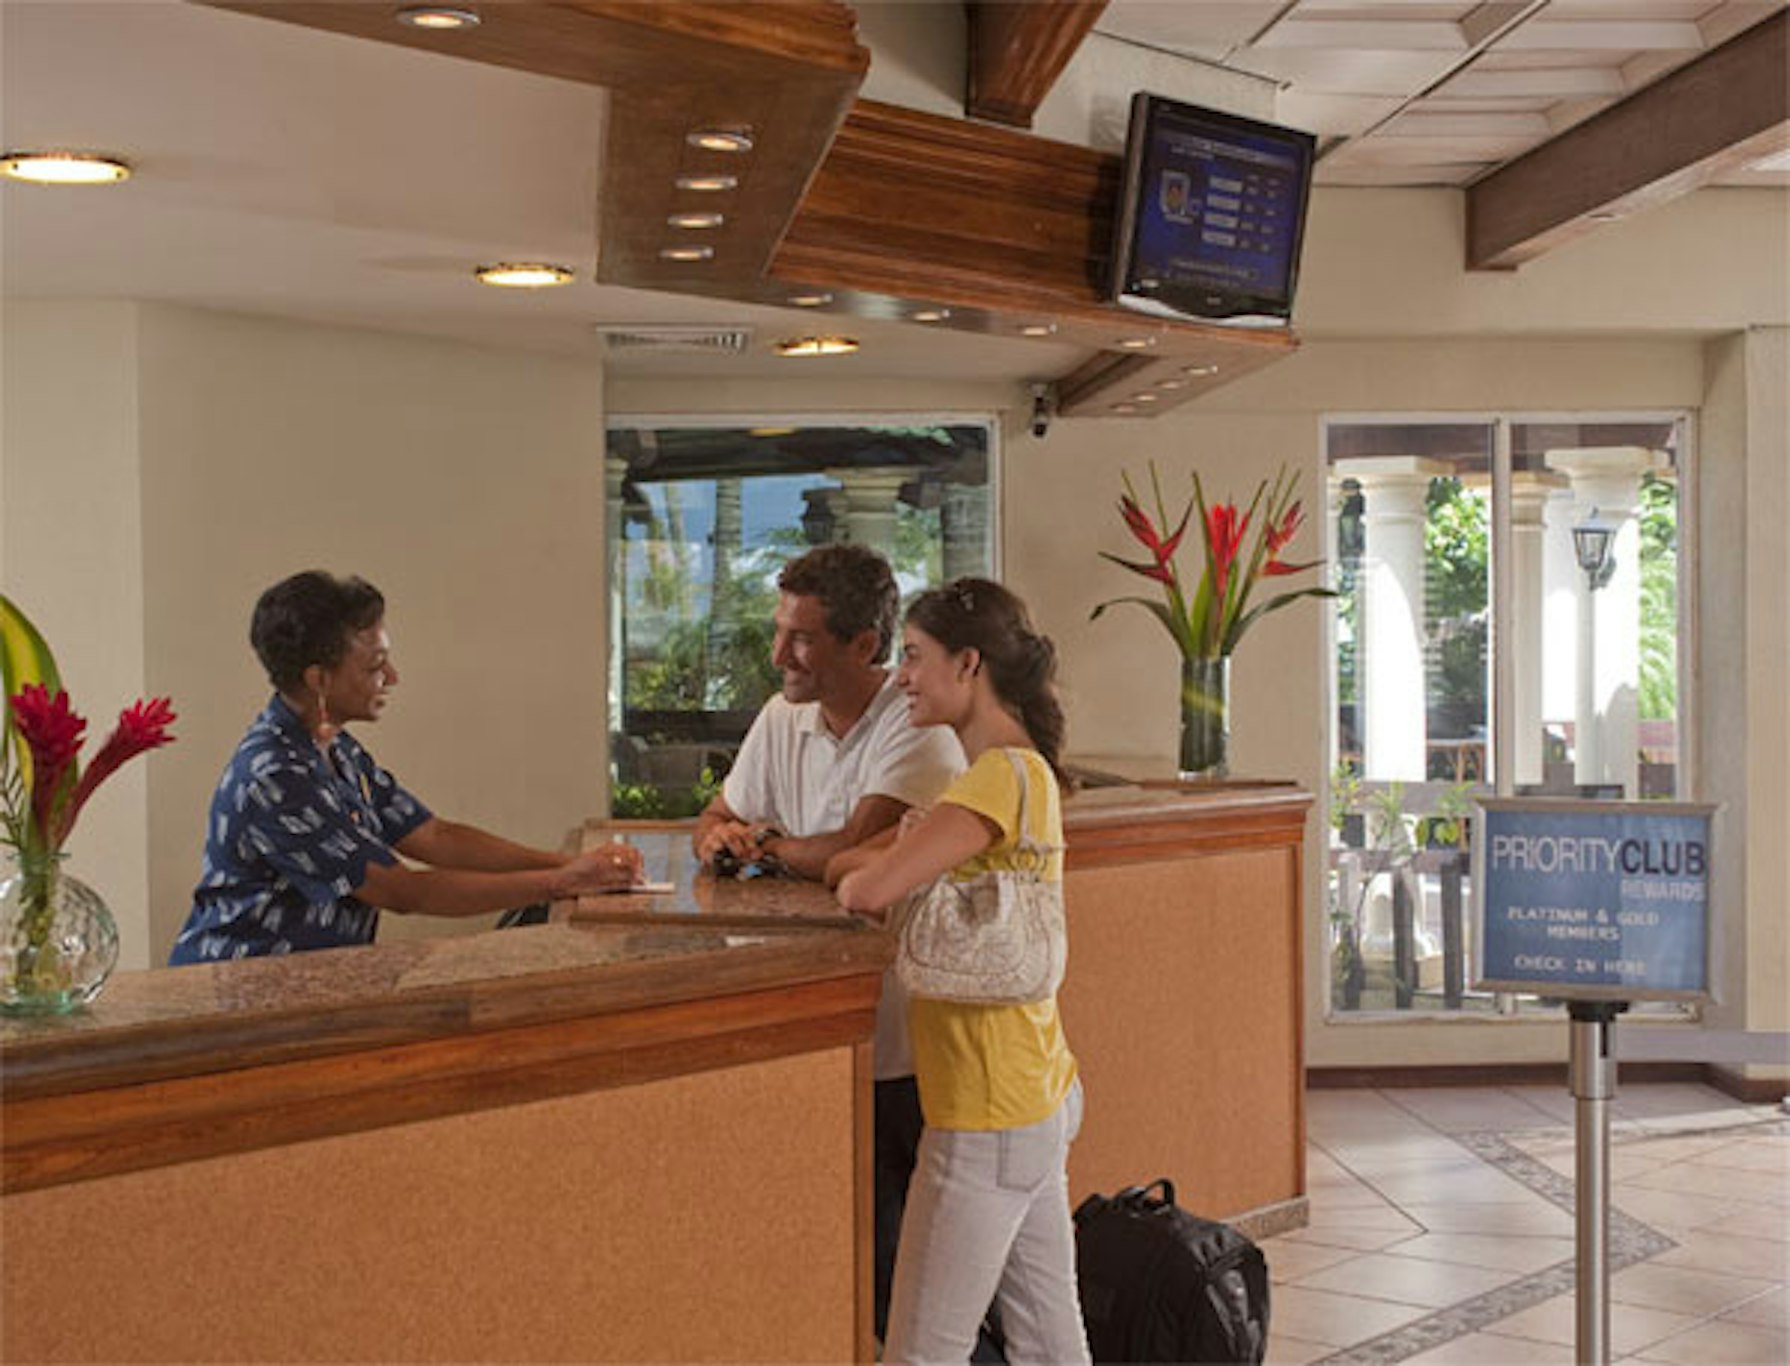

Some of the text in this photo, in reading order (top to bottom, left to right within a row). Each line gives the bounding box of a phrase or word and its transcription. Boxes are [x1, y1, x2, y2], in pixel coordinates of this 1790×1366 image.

[1620, 878, 1705, 901] REWARDS
[1508, 906, 1659, 926] PLATINUM & GOLD
[1547, 925, 1620, 941] MEMBERS
[1514, 954, 1648, 976] CHECK IN HERE
